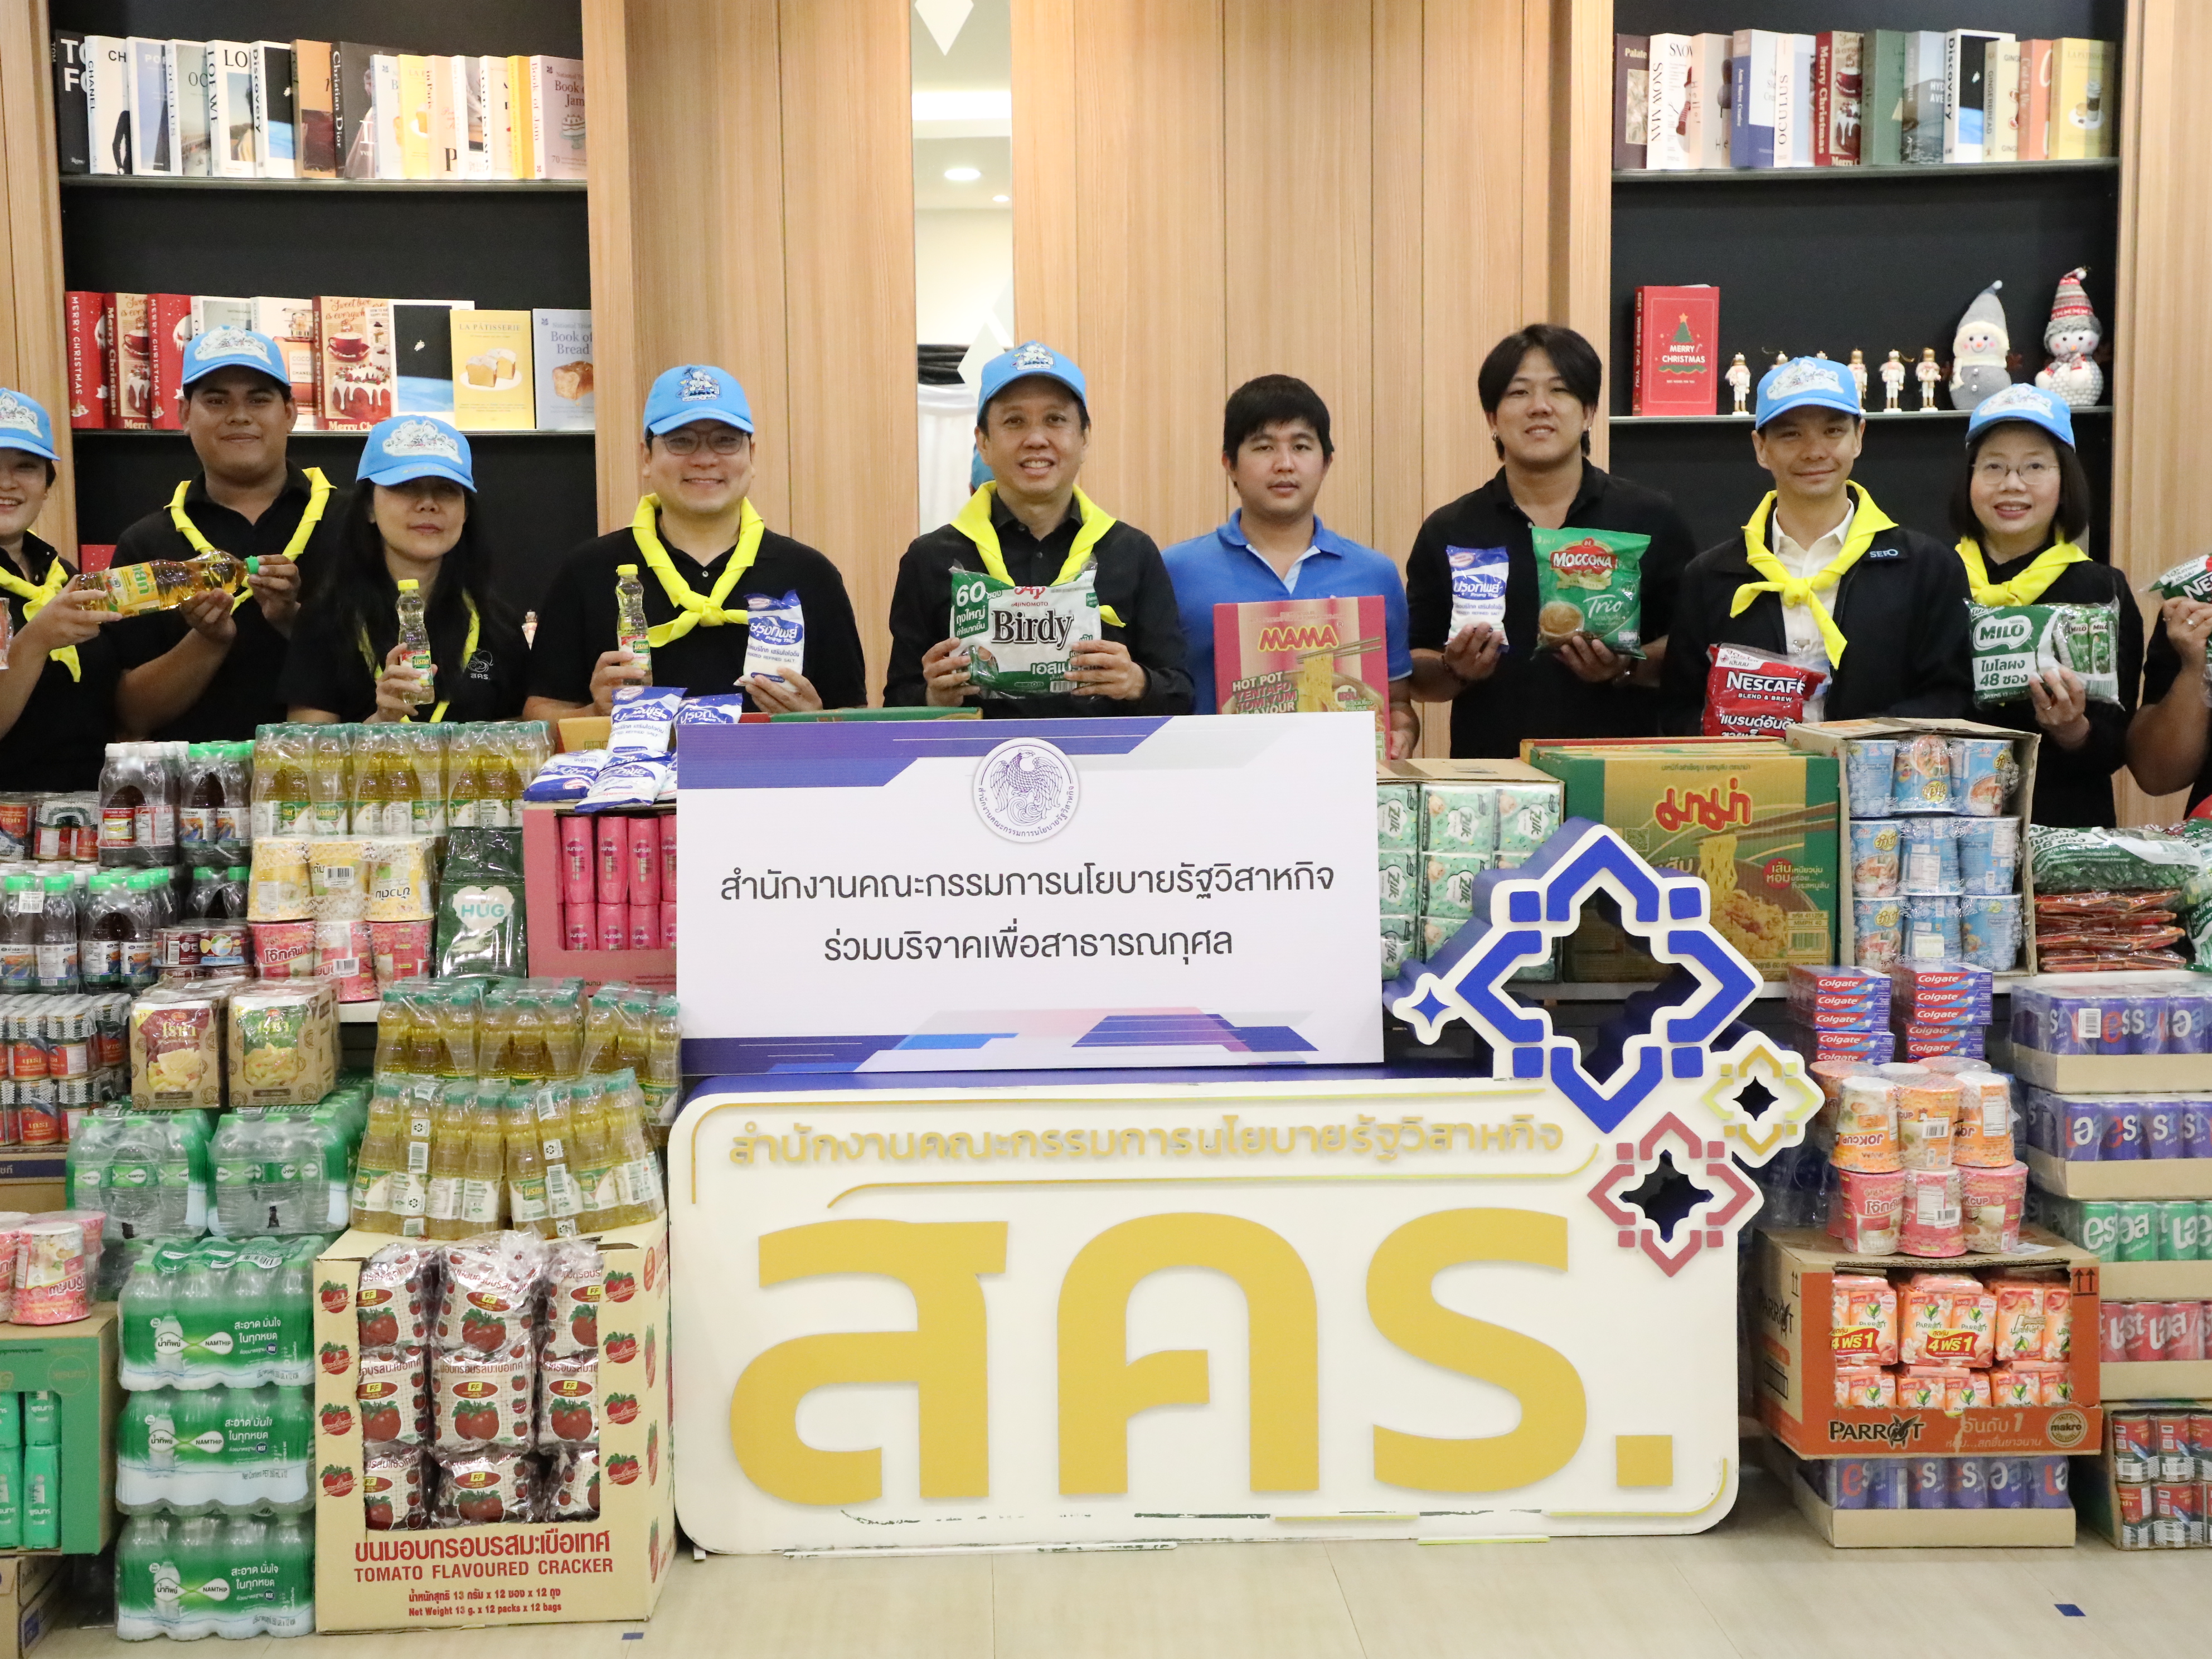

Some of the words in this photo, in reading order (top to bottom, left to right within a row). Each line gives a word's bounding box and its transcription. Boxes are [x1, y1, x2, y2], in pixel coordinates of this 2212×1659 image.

[1818, 45, 1828, 85] Merry
[555, 80, 578, 92] Book
[1652, 62, 1663, 106] SNOW
[1945, 38, 1956, 120] Discovery
[253, 48, 261, 133] Discovery
[533, 99, 539, 110] of
[1778, 75, 1789, 145] OCULUS
[1651, 109, 1662, 142] MAN
[1818, 88, 1828, 154] Christmas
[71, 297, 80, 332] MERRY
[551, 331, 579, 342] Book
[557, 343, 590, 355] Bread
[1669, 345, 1695, 353] MERRY
[73, 337, 83, 395] CHRISTMAS
[1662, 355, 1706, 363] CHRISTMAS
[1553, 552, 1612, 568] MOCCONA
[956, 581, 987, 608] 60
[987, 589, 1003, 600] ซอง
[1583, 594, 1624, 620] Trio
[956, 605, 986, 627] ถุงใหญ่
[991, 608, 1075, 651] Birdy
[1980, 624, 2025, 641] MILO
[1258, 624, 1340, 653] MAMA
[1981, 658, 2026, 672] ไมโลผง
[1232, 676, 1258, 692] HOT
[1260, 671, 1284, 687] POT
[1980, 673, 2000, 686] 48
[2002, 673, 2029, 685] ซอง
[1235, 681, 1293, 704] YENTAFO
[1239, 697, 1265, 711] TOM
[1267, 691, 1298, 707] YUM
[1655, 777, 1753, 832] มาม่า
[721, 861, 1335, 901] สำนักงานคณะกรรมการนโยบายรัฐวิสาหกิจ
[1766, 873, 1791, 884] หอม
[461, 903, 506, 919] HUG
[824, 918, 1233, 965] ร่วมบริจาคเพื่อสาธารณกุศล
[1818, 978, 1859, 988] Colgate
[1918, 974, 1959, 984] Colgate
[1818, 996, 1858, 1006] Colgate
[1917, 992, 1959, 1002] Colgate
[1816, 1014, 1857, 1024] Colgate
[1917, 1010, 1959, 1020] Colgate
[1909, 1026, 1950, 1035] Colgate
[1820, 1035, 1861, 1044] Colgate
[1909, 1044, 1951, 1053] Colgate
[729, 1114, 1564, 1164] สำนักงานคณะกรรมการนโยบายรัฐวิสาหกิจ
[234, 1320, 261, 1331] สะอาด
[263, 1315, 282, 1328] มั่นใจ
[1915, 1321, 1943, 1329] PARROT
[1961, 1323, 1987, 1332] PARROT
[158, 1337, 181, 1348] น้ำทิพย์
[239, 1332, 278, 1345] ในทุกหยด
[1841, 1333, 1863, 1349] ฟรี
[1865, 1332, 1875, 1348] 1
[1928, 1338, 1940, 1352] 4
[1941, 1336, 1961, 1352] ฟรี
[1962, 1336, 1973, 1350] 1
[729, 1206, 1673, 1507] สคร.
[225, 1418, 251, 1428] สะอาด
[2014, 1412, 2025, 1432] 1
[2050, 1422, 2082, 1432] makro
[229, 1430, 269, 1443] ในทุกหยด
[1828, 1417, 1927, 1445] PARROT
[151, 1434, 174, 1445] น้ำทิพย์
[355, 1527, 611, 1563] ขนมอบกรอบรสมะเขือเทศ
[231, 1565, 258, 1576] สะอาด
[354, 1565, 424, 1583] TOMATO
[432, 1560, 530, 1580] FLAVOURED
[538, 1558, 614, 1575] CRACKER
[236, 1578, 275, 1590] ในทุกหยด
[453, 1590, 464, 1600] 13
[467, 1587, 484, 1600] กรัม
[494, 1589, 506, 1599] 12
[536, 1588, 548, 1598] 12
[409, 1607, 424, 1617] Net
[425, 1605, 453, 1618] Weight
[455, 1605, 466, 1614] 13
[486, 1604, 496, 1614] 12
[497, 1603, 521, 1615] packs
[531, 1603, 541, 1612] 12
[543, 1602, 562, 1613] bags
